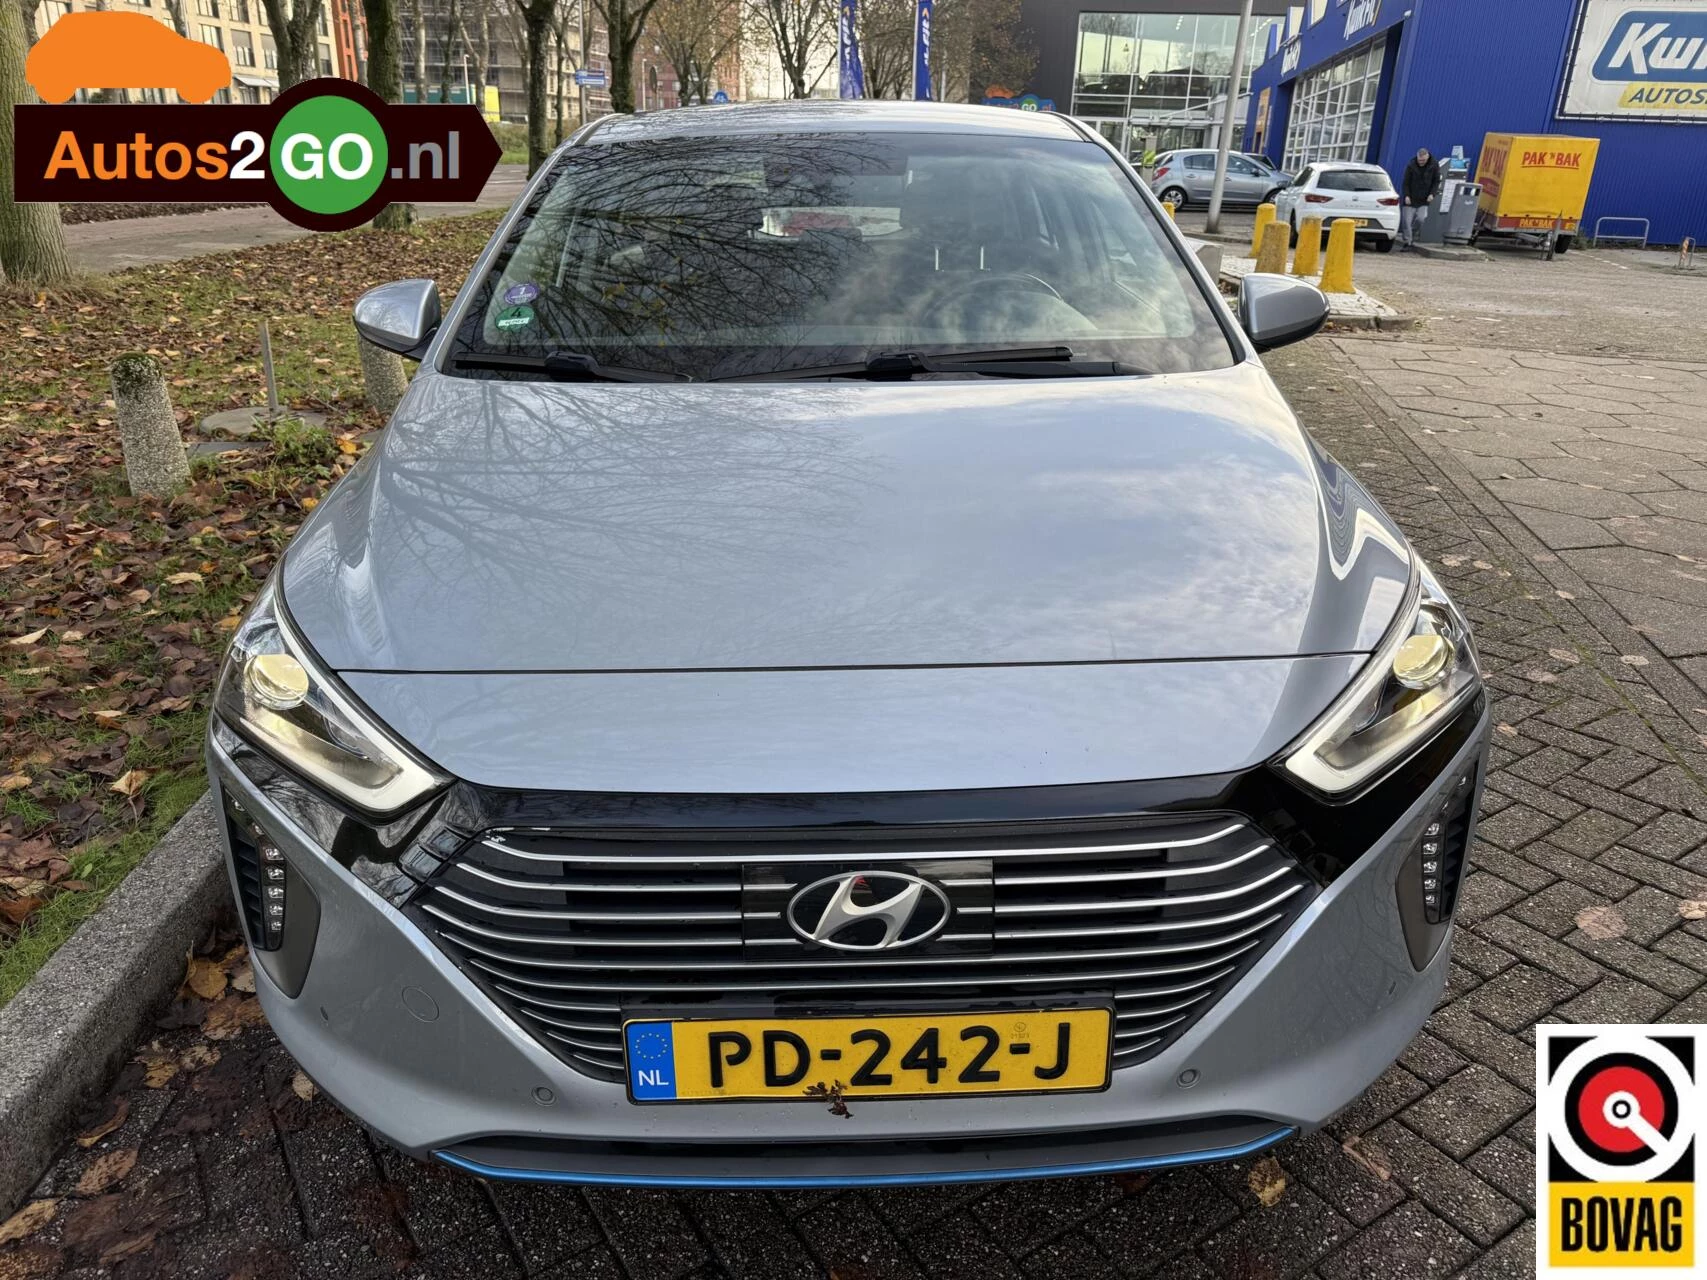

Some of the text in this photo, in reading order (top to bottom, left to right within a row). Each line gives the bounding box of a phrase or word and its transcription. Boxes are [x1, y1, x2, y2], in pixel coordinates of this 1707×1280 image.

[1628, 87, 1707, 104] AUTOS
[1522, 151, 1547, 165] PAK
[1555, 152, 1582, 167] BAK
[708, 1022, 1071, 1088] PD-242-J
[638, 1070, 669, 1087] NL
